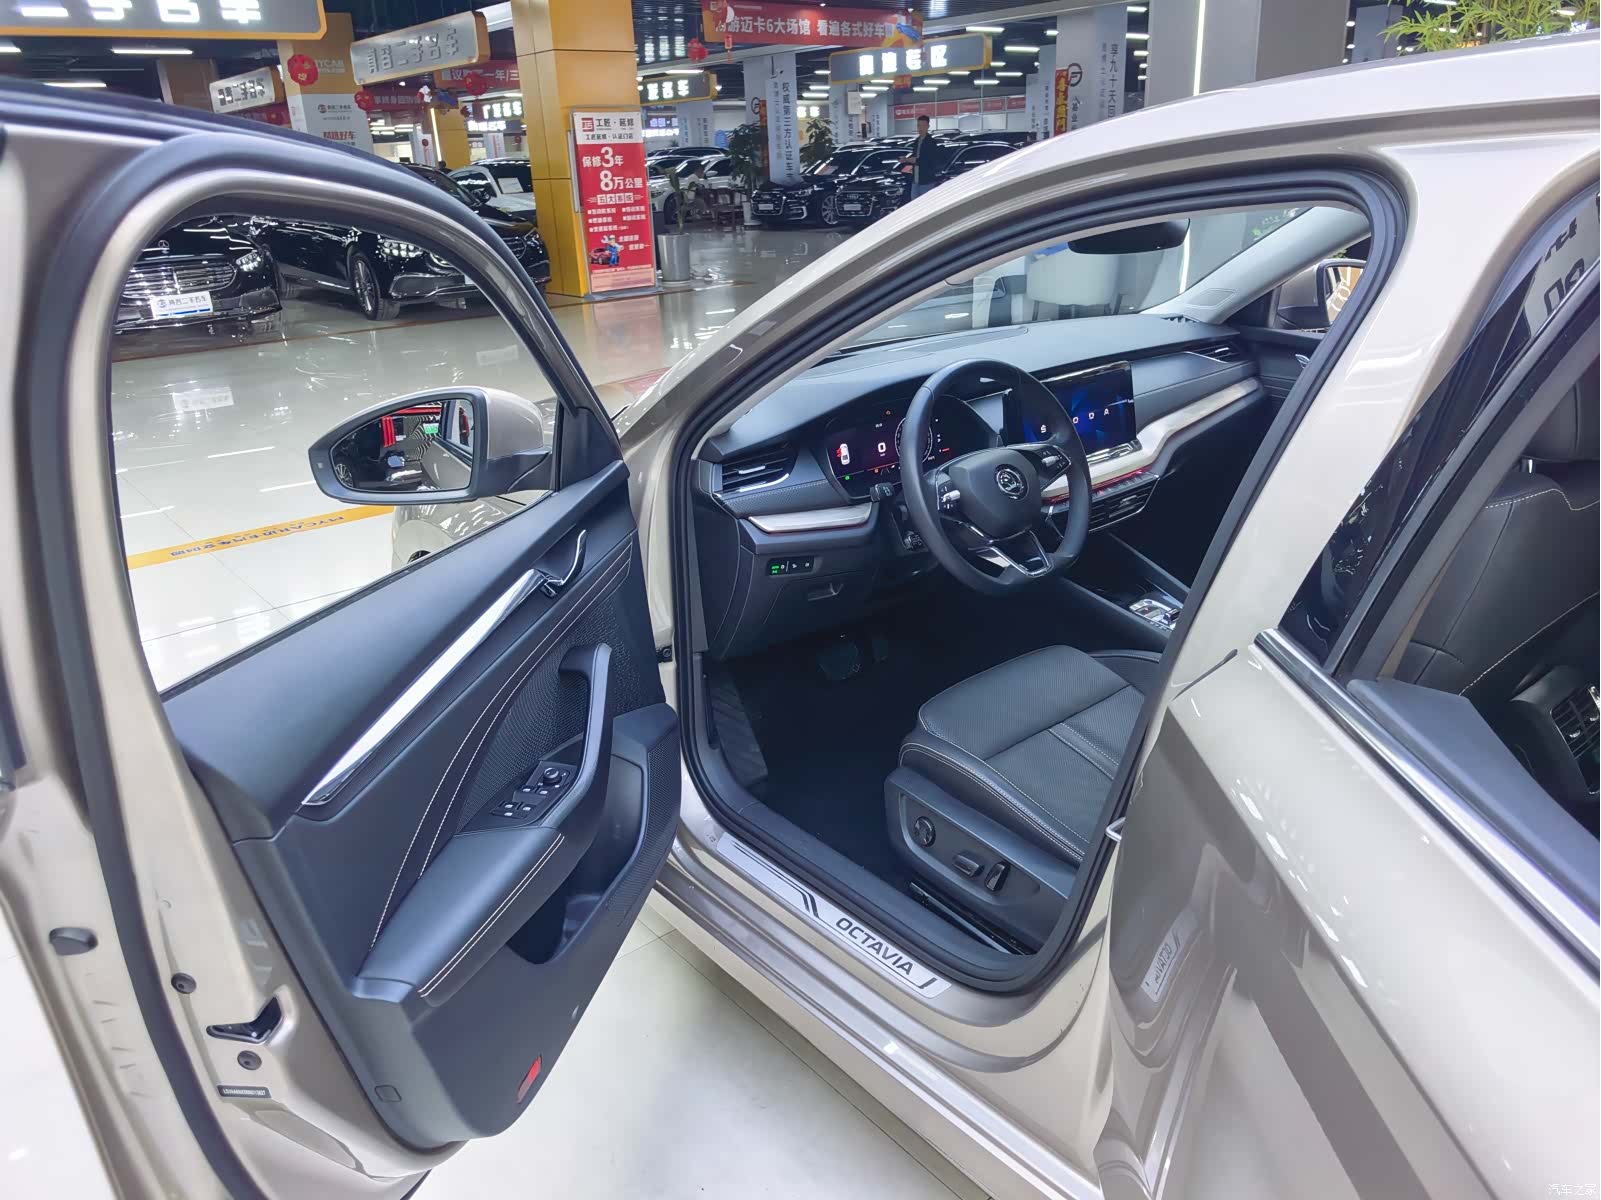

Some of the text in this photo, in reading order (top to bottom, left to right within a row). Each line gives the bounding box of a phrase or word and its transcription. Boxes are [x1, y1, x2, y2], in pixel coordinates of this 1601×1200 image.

[582, 147, 624, 168] 保修3年
[600, 170, 643, 191] 8万公里
[878, 442, 887, 453] 0
[835, 917, 914, 976] OCTAVIA
